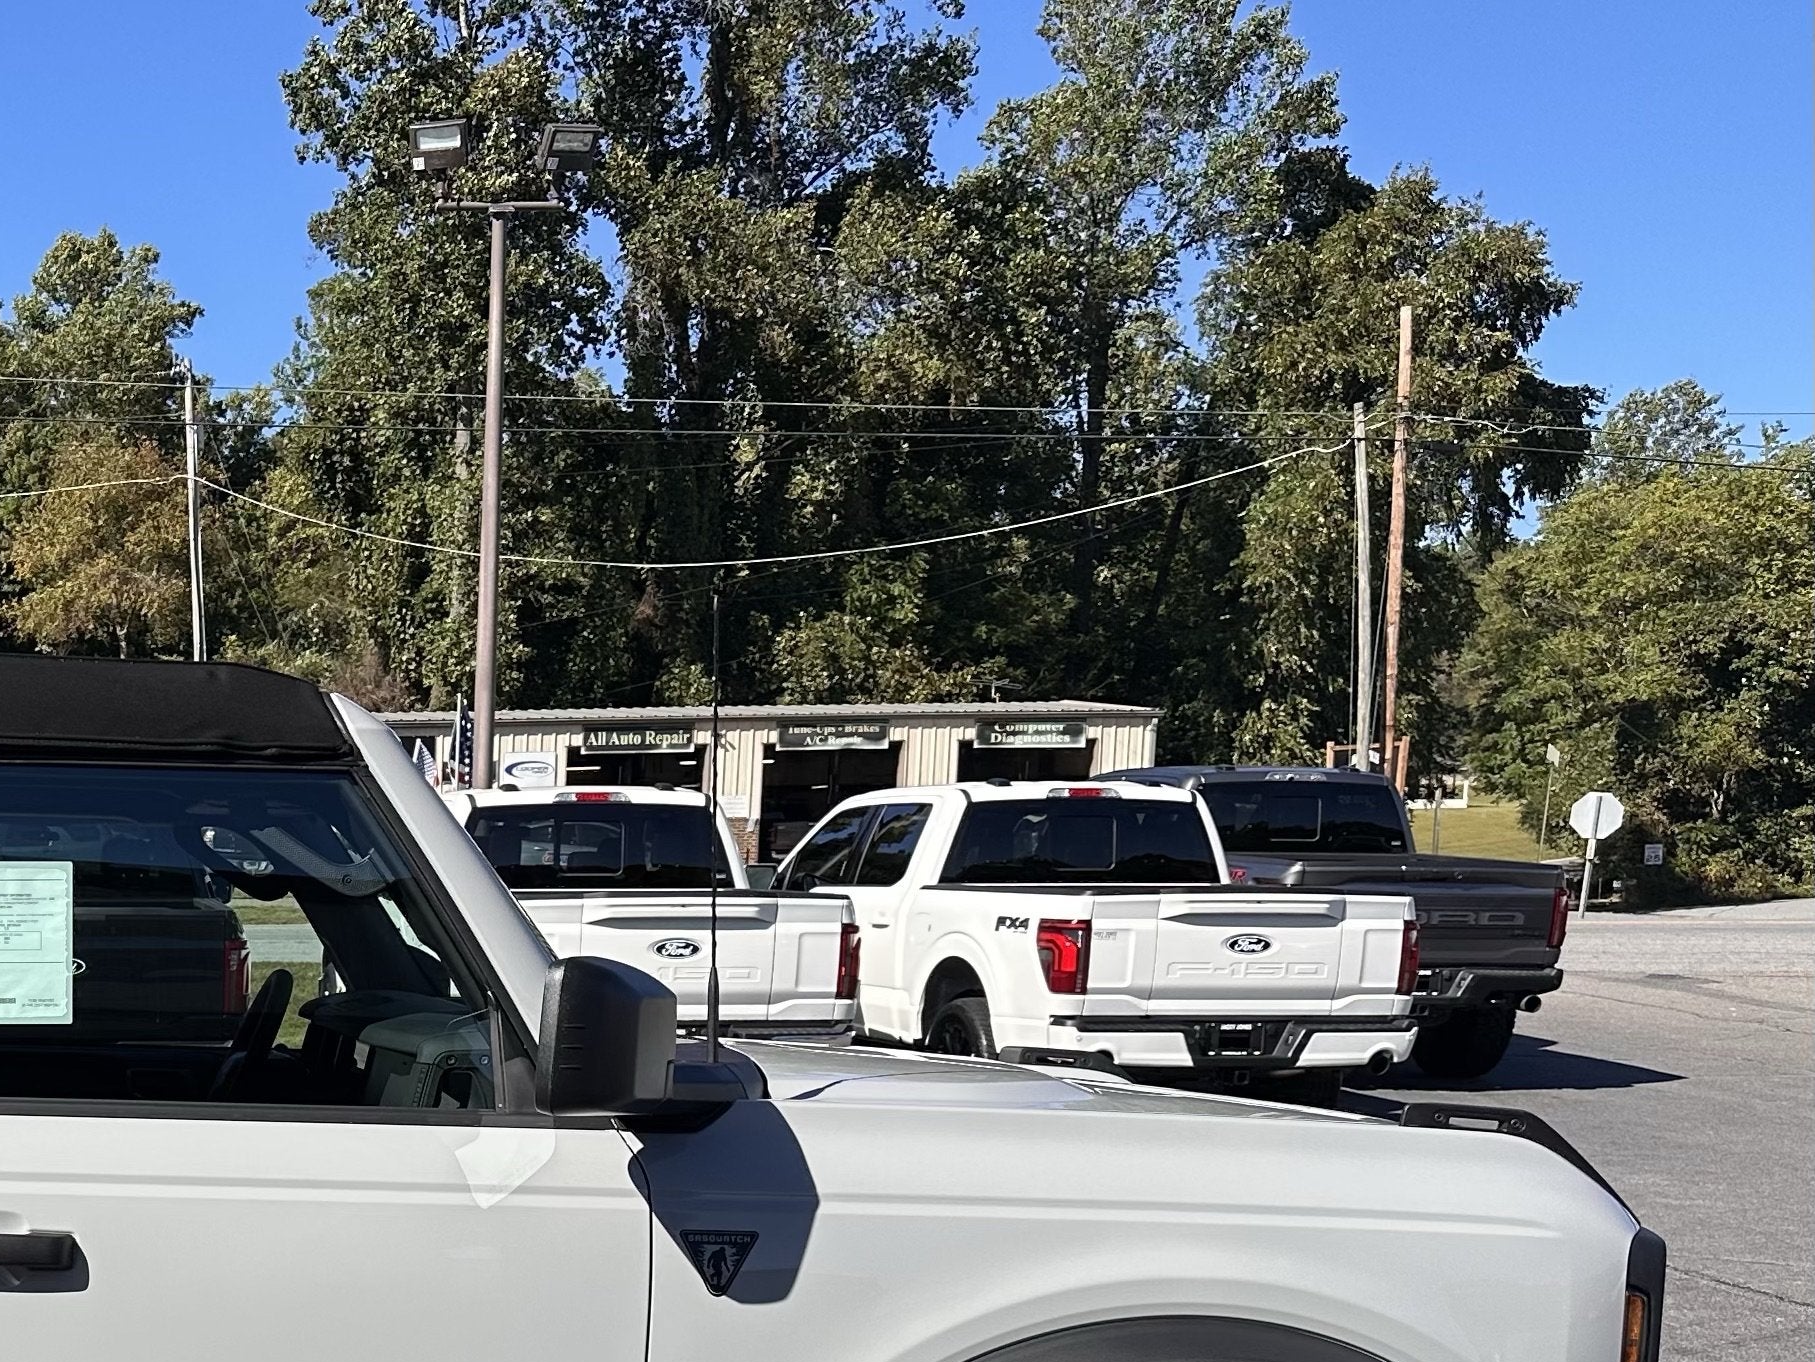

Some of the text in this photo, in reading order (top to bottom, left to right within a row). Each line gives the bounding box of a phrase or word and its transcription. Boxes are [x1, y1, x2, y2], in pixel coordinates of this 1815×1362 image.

[994, 723, 1065, 733] Computer
[586, 730, 691, 748] All Auto Repair
[990, 732, 1071, 745] Diagnostics
[995, 916, 1030, 931] FX4
[1166, 961, 1328, 979] F-150
[687, 1234, 751, 1243] SASQUATCH
